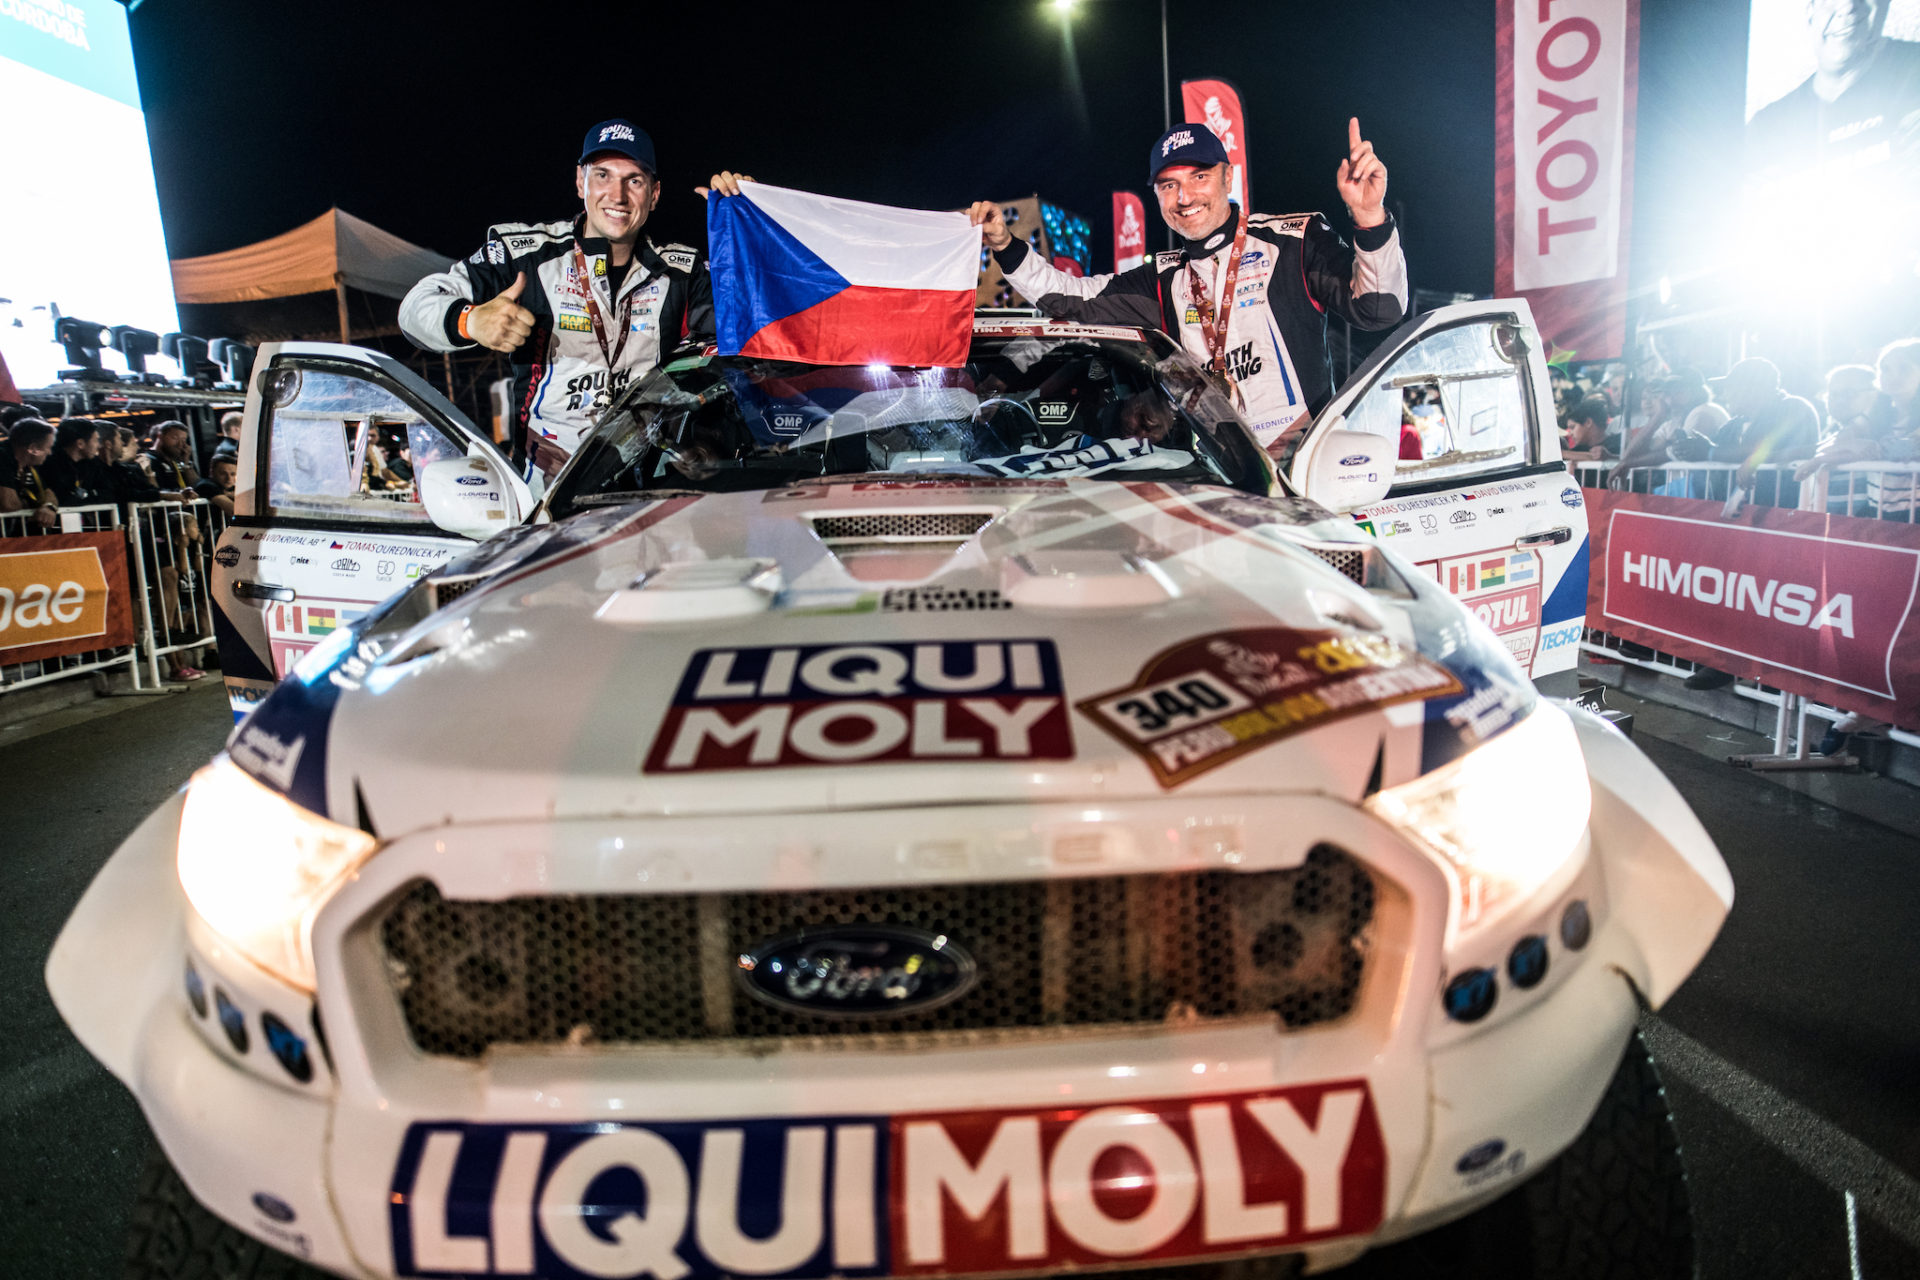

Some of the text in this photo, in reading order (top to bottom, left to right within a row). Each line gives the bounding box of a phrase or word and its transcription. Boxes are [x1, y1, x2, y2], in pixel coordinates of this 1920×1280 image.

[599, 124, 633, 137] SOUTH
[1162, 130, 1191, 148] SOUTH
[1280, 222, 1303, 230] OMP
[511, 239, 535, 248] OMP
[668, 255, 691, 265] OMP
[560, 315, 591, 324] MANN
[560, 322, 592, 331] FILTER
[1040, 404, 1068, 416] OMP
[774, 416, 803, 427] OMP
[1250, 416, 1294, 432] UREDNICEK
[1397, 497, 1451, 512] OUREDNICEK
[375, 544, 433, 558] OUREDNICEK
[1623, 551, 1855, 639] HIMOINSA
[1468, 595, 1530, 630] OTUL
[695, 643, 1045, 697] LIQUI
[1116, 678, 1235, 732] 340
[664, 698, 1059, 769] MOLY
[410, 1088, 1364, 1280] LIQUI MOLY
